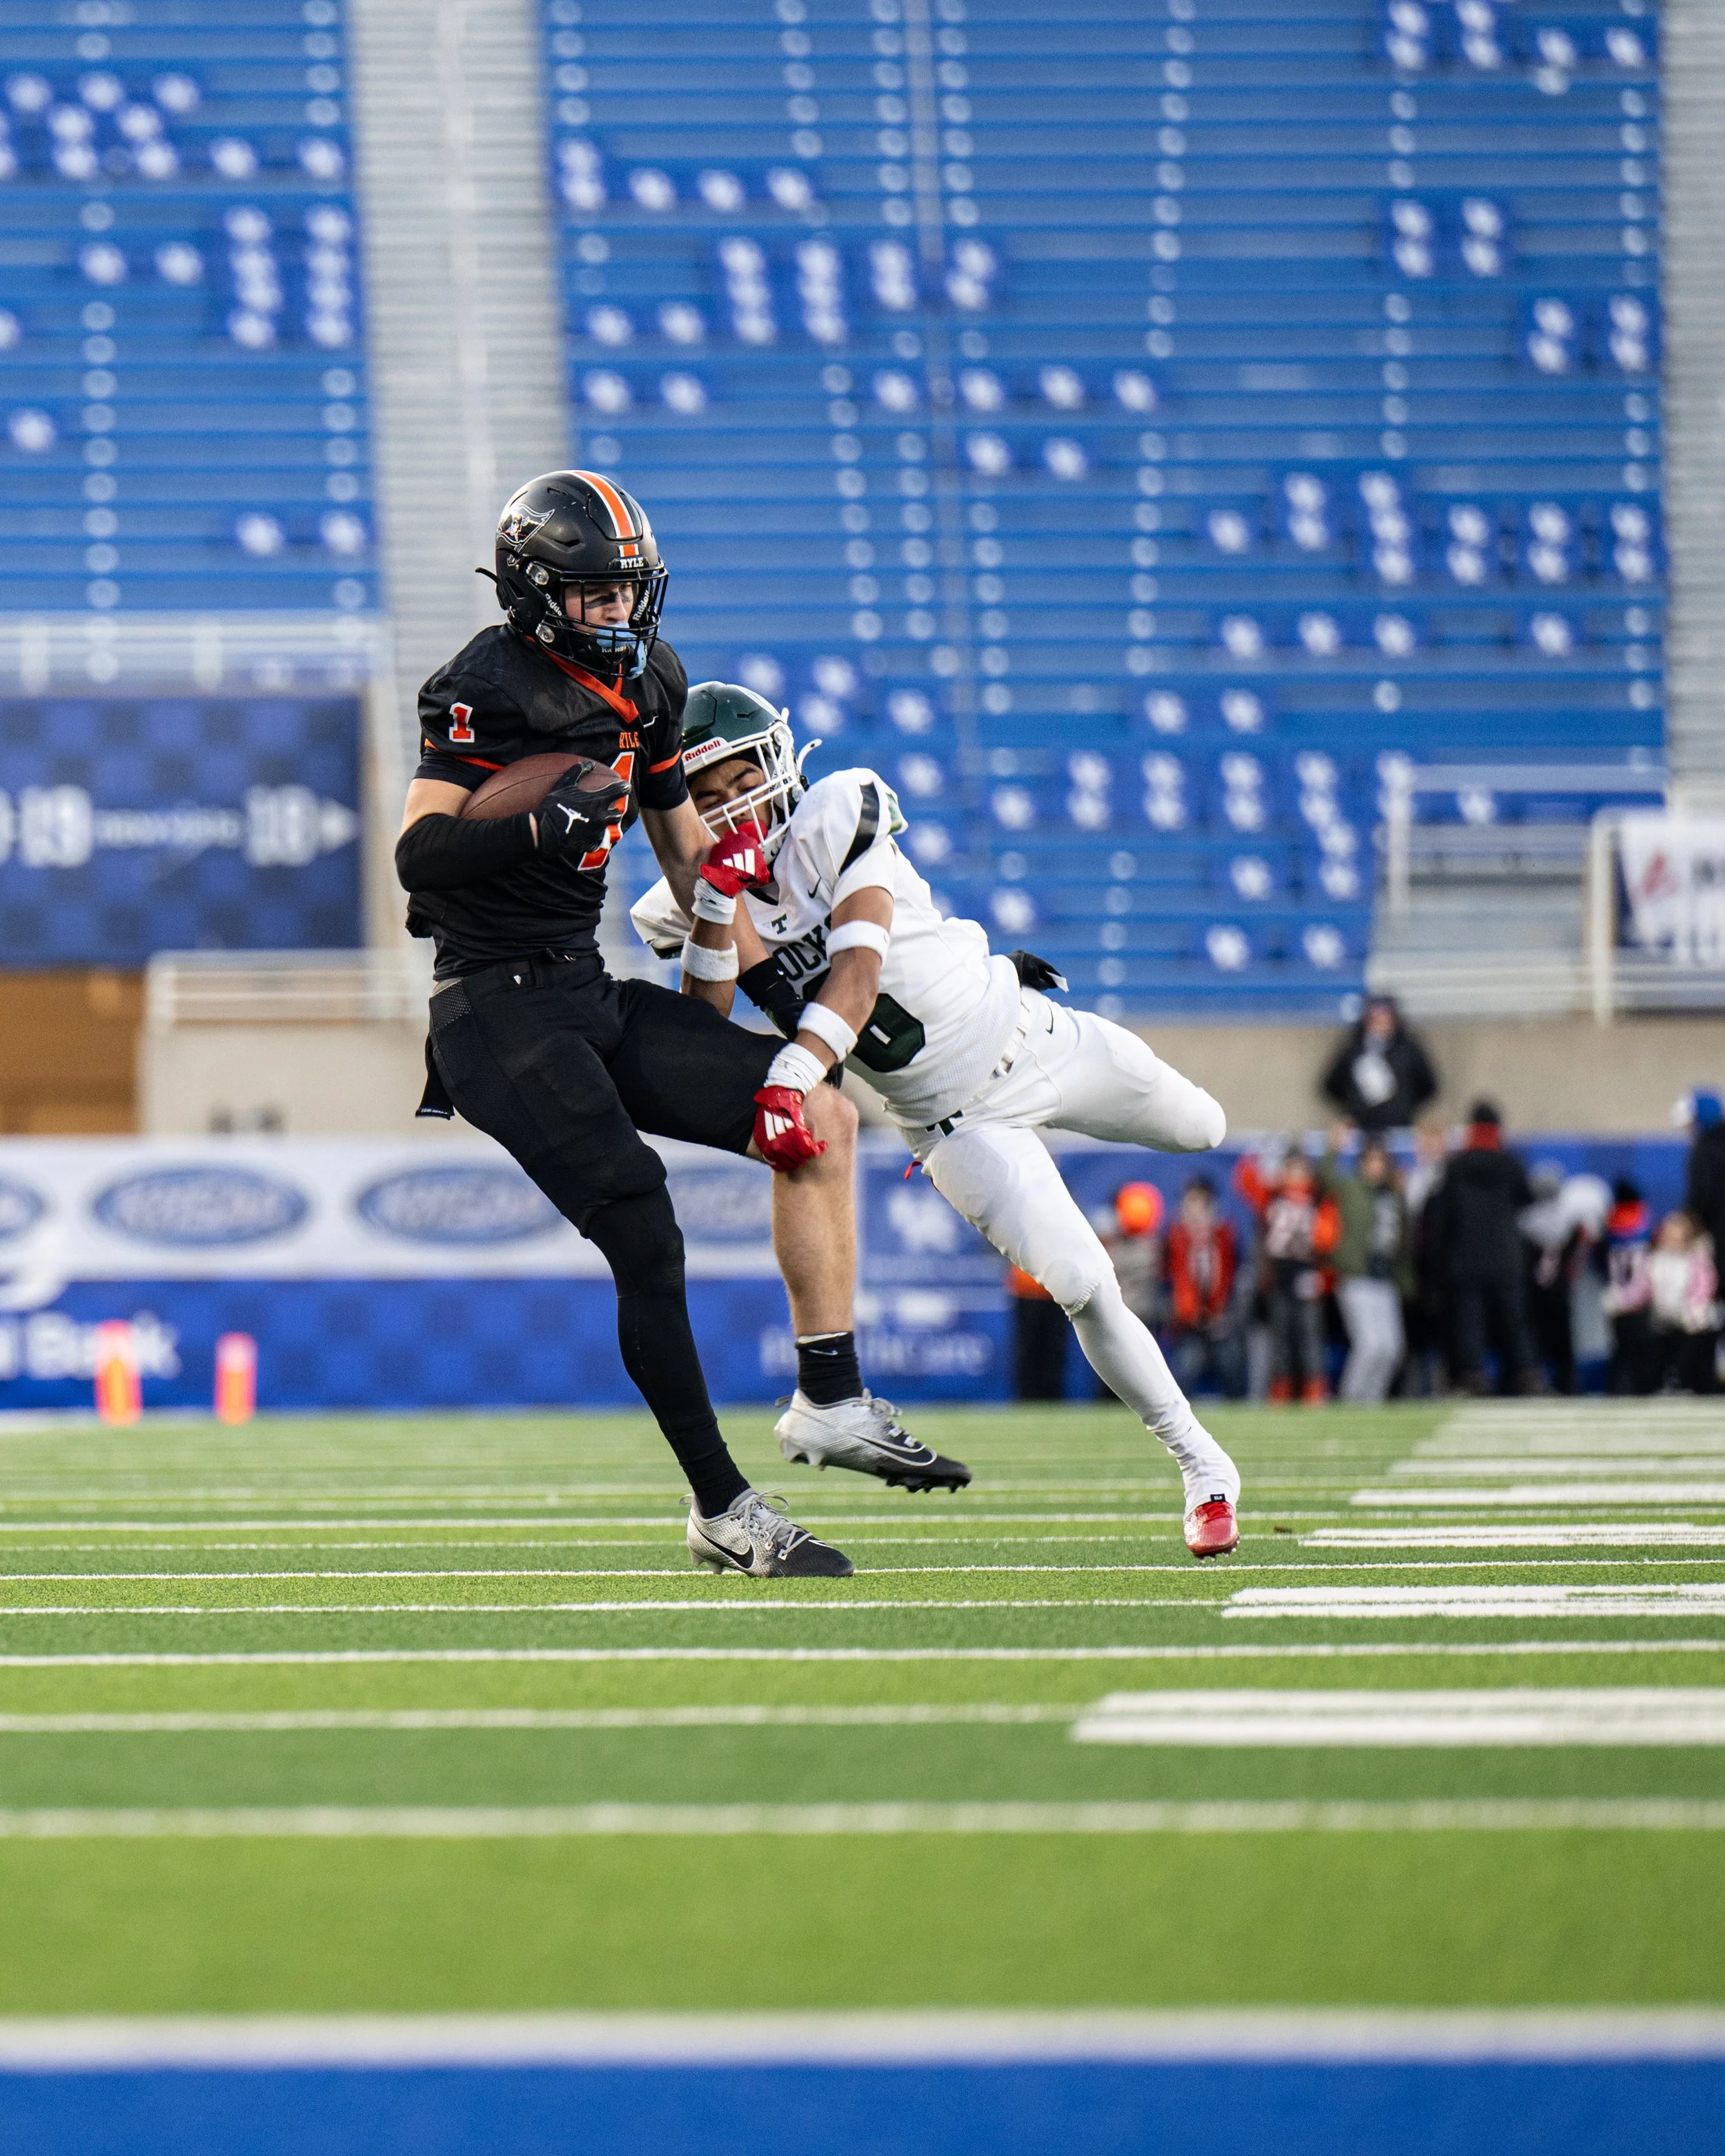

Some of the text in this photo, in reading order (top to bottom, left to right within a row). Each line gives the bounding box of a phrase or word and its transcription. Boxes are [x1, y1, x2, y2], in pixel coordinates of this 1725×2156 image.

[620, 557, 644, 569] RYLE
[632, 589, 649, 621] Riddell
[448, 702, 475, 743] 1
[619, 731, 640, 749] RYLE
[684, 740, 721, 762] Riddell
[771, 912, 788, 935] T
